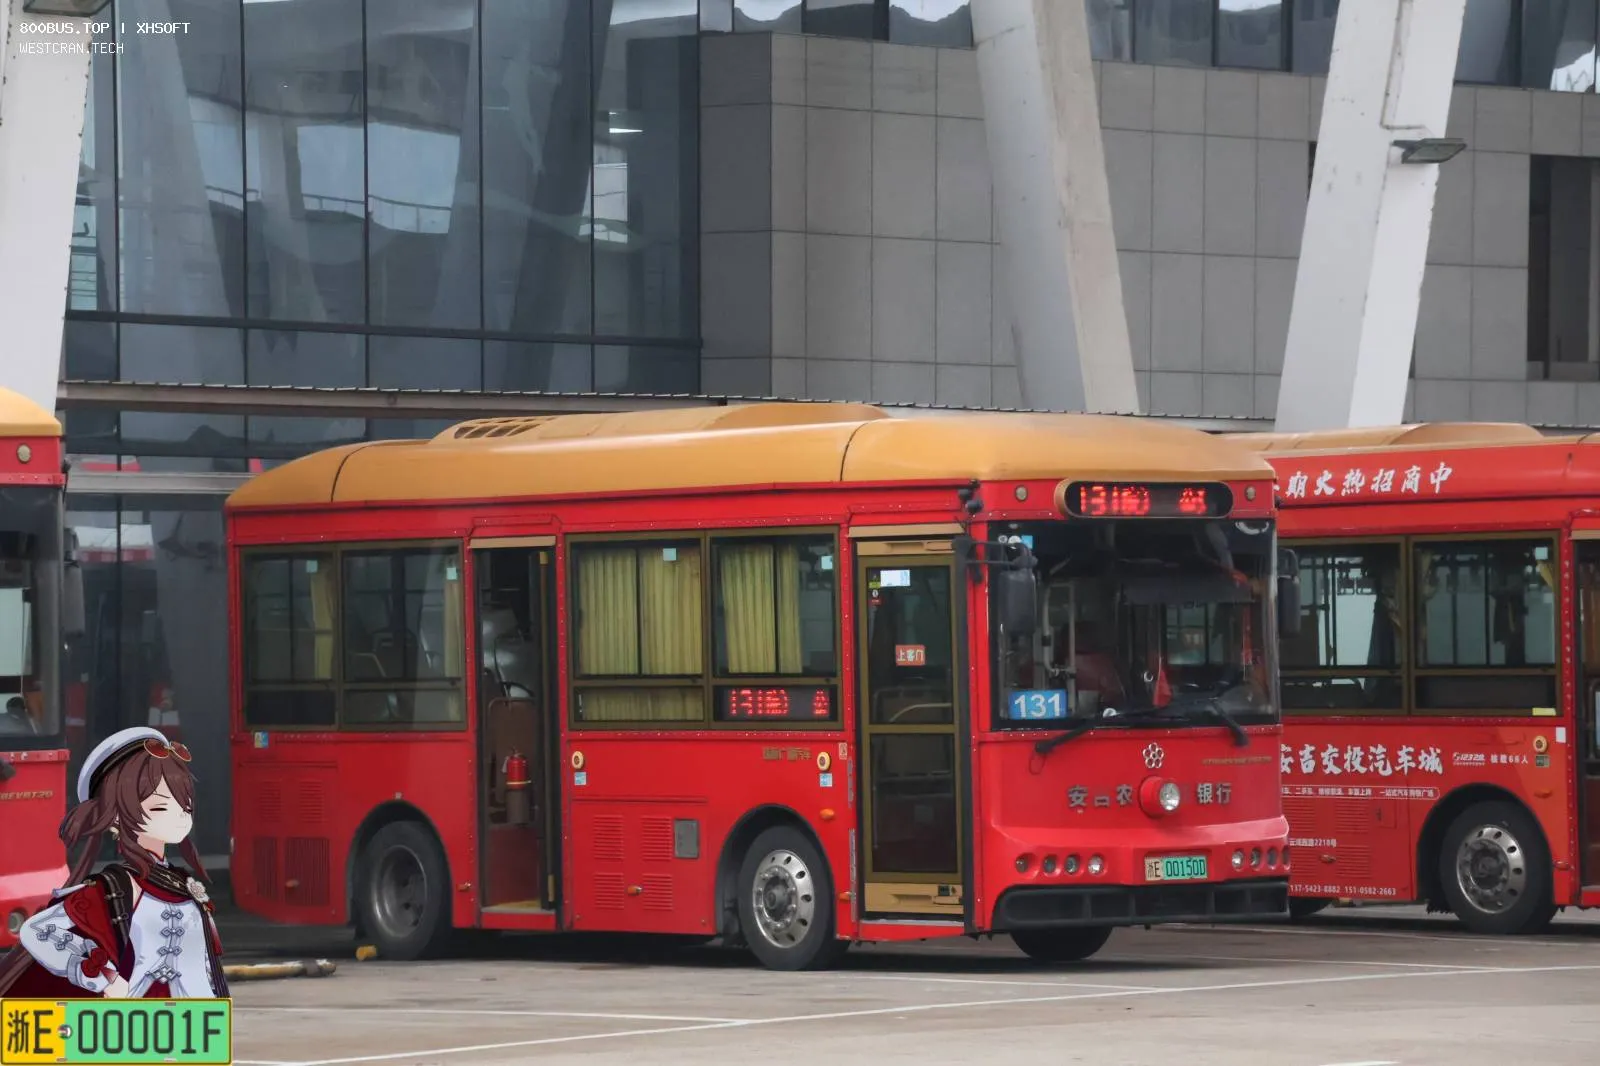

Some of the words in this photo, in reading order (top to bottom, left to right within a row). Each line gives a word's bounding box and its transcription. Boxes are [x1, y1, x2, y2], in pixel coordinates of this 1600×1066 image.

[1273, 462, 1453, 499] 期火热招商中
[1014, 693, 1064, 718] 131
